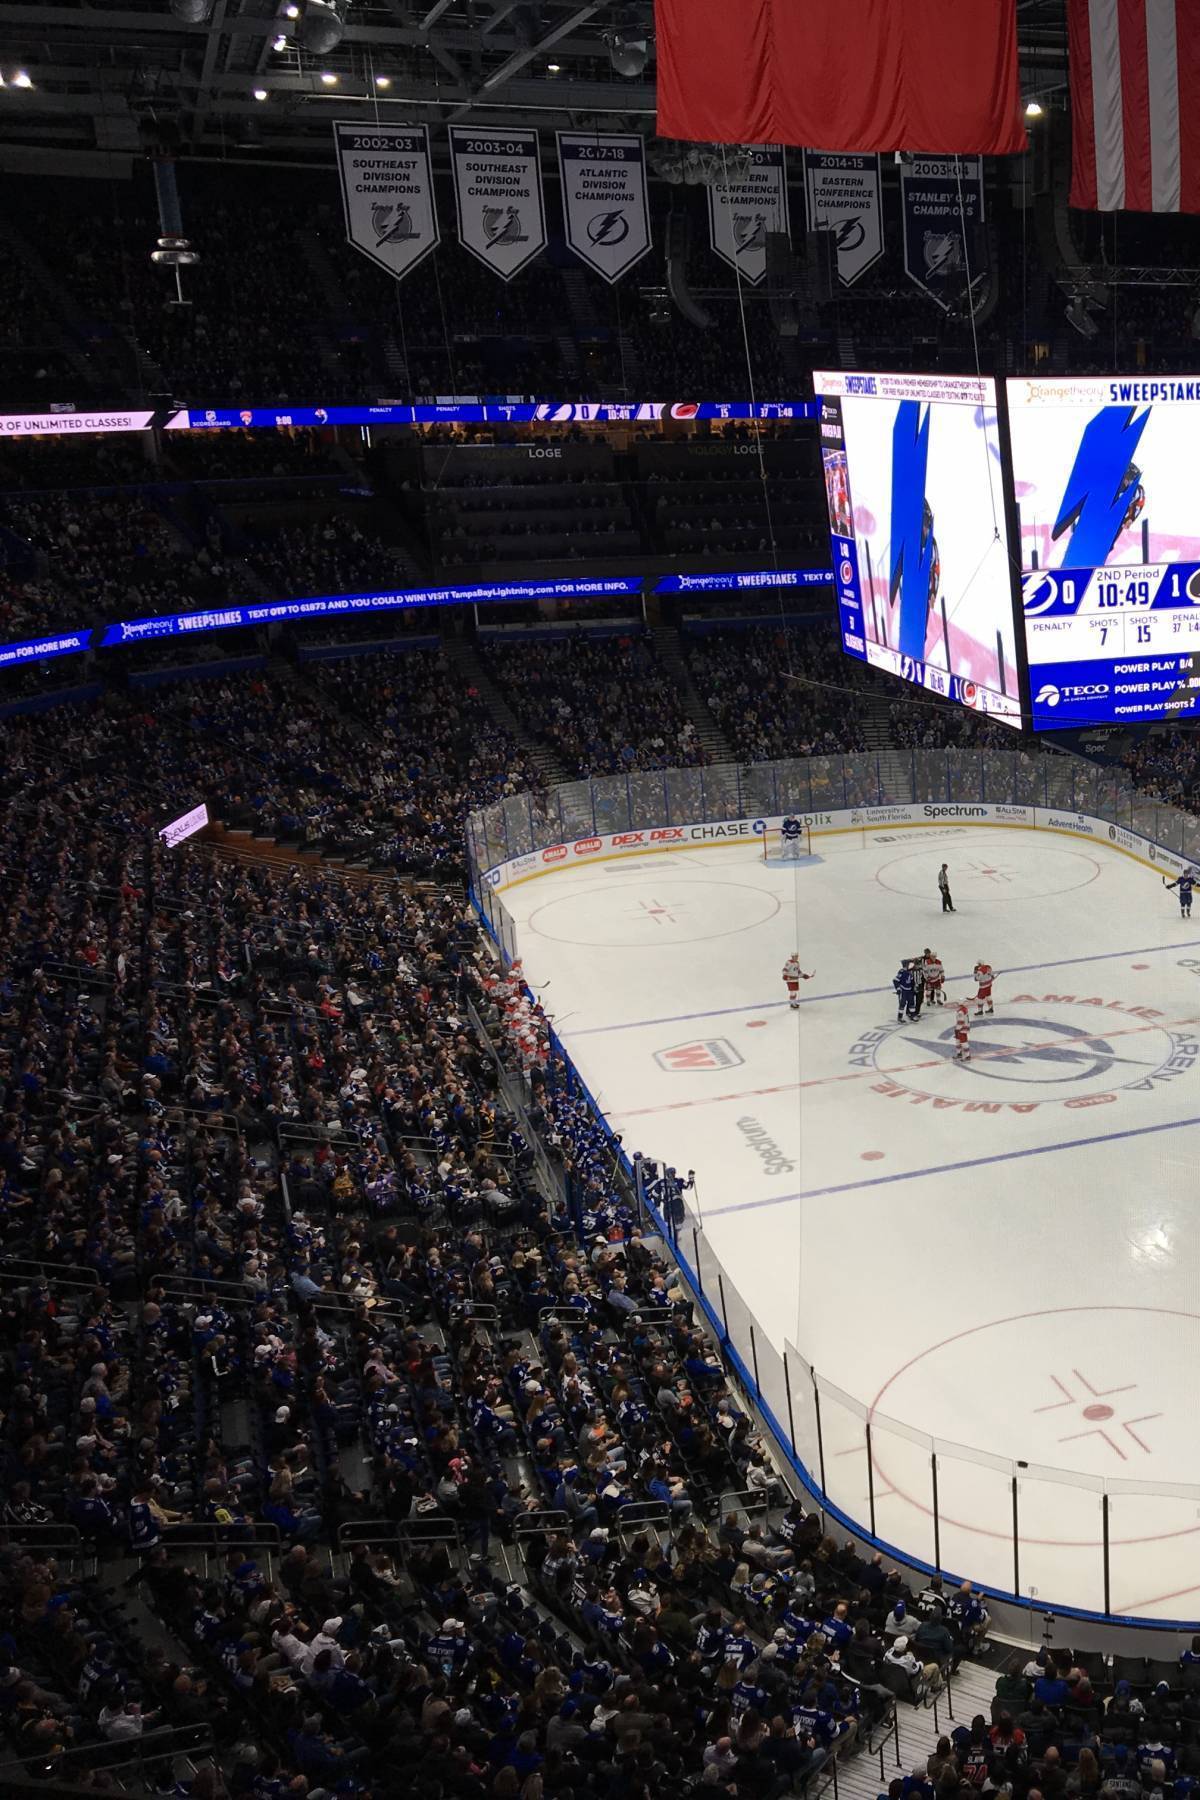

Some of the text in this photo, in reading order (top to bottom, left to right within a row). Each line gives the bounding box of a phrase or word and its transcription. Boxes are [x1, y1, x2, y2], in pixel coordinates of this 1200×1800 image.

[353, 137, 413, 150] 2002-03
[466, 141, 524, 154] 2003-04
[352, 159, 418, 169] SOUTHEAST
[465, 163, 528, 173] SOUTHEAST
[820, 157, 864, 168] 2014-15
[579, 169, 628, 178] ATLANTIC
[914, 164, 969, 176] 2003-04
[363, 172, 410, 182] DIVISION
[475, 175, 520, 185] DIVISION
[822, 177, 864, 187] EASTERN
[355, 184, 421, 194] CHAMPIONS
[582, 180, 626, 190] DIVISION
[467, 187, 530, 198] CHAMPIONS
[575, 192, 635, 201] CHAMPIONS
[813, 188, 873, 198] CONFERENCE
[908, 192, 954, 202] STANLEY
[817, 199, 871, 209] CHAMPIONS
[607, 409, 630, 419] 10:49
[7, 421, 21, 430] OF
[24, 419, 83, 430] UNLIMITED
[84, 418, 131, 428] CLASSES!
[529, 448, 562, 458] LOGE
[734, 444, 765, 454] LOGE
[737, 573, 824, 587] SWEEPSTAKES TEXT
[1096, 569, 1160, 582] 2ND Period
[1062, 580, 1076, 604] 0
[1171, 574, 1180, 598] 1
[1097, 581, 1150, 608] 10:49
[178, 582, 629, 630] SWEEPSTAKES TEXT TO 61873 AND YOU COULD VISIT TampaBayLightning.com FOR MORE INFO.
[1089, 619, 1119, 628] SHOTS
[1129, 616, 1158, 625] SHOTS
[1033, 622, 1073, 632] PENALTY
[1099, 627, 1108, 646] 7
[1137, 625, 1151, 643] 15
[16, 638, 80, 657] FOR MORE INFO.
[1114, 658, 1194, 674] POWER PLAY 0/4
[930, 672, 945, 693] 10:49
[1114, 681, 1176, 695] POWER PLAY
[1060, 684, 1110, 696] TECO
[1114, 700, 1189, 714] POWER PLAY SHOTS
[924, 805, 984, 819] Spectrum
[650, 828, 684, 841] DEX
[690, 823, 749, 840] CHASE
[611, 832, 645, 846] DEX
[619, 841, 649, 849] imaging
[658, 837, 688, 845] imaging
[1010, 993, 1166, 1020] AMALIE
[1123, 1031, 1200, 1092] ARENA
[869, 1080, 1039, 1114] AMALIE
[736, 1116, 798, 1176] Spectrum
